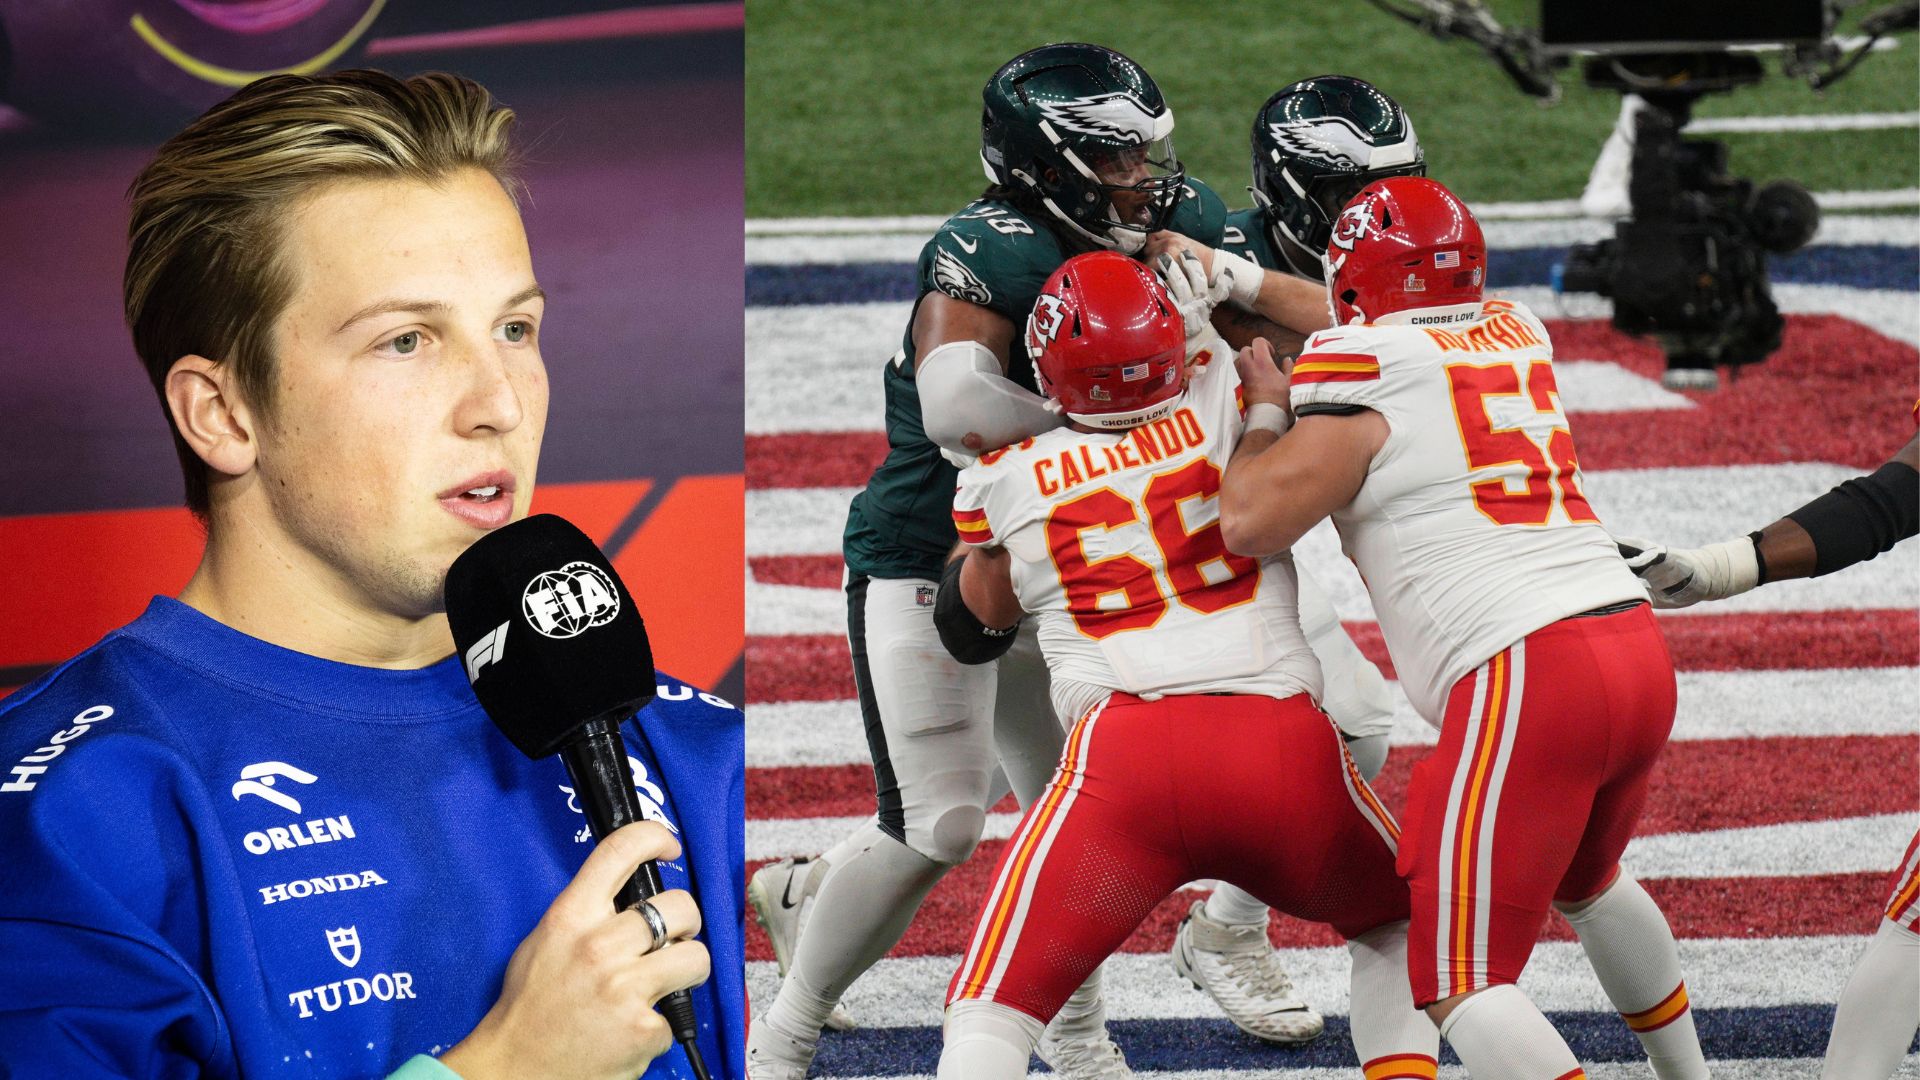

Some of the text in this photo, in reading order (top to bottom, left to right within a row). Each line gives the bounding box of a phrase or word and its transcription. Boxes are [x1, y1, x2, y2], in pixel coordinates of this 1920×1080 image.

[1411, 312, 1475, 326] CHOOSE LOVE
[1101, 406, 1169, 427] CHOOSE LOVE
[1033, 407, 1207, 497] CALIENDO
[1043, 455, 1263, 641] 66
[0, 704, 115, 793] HUGO
[243, 814, 357, 855] ORLEN
[258, 869, 389, 905] HONDA
[288, 971, 418, 1020] TUDOR
